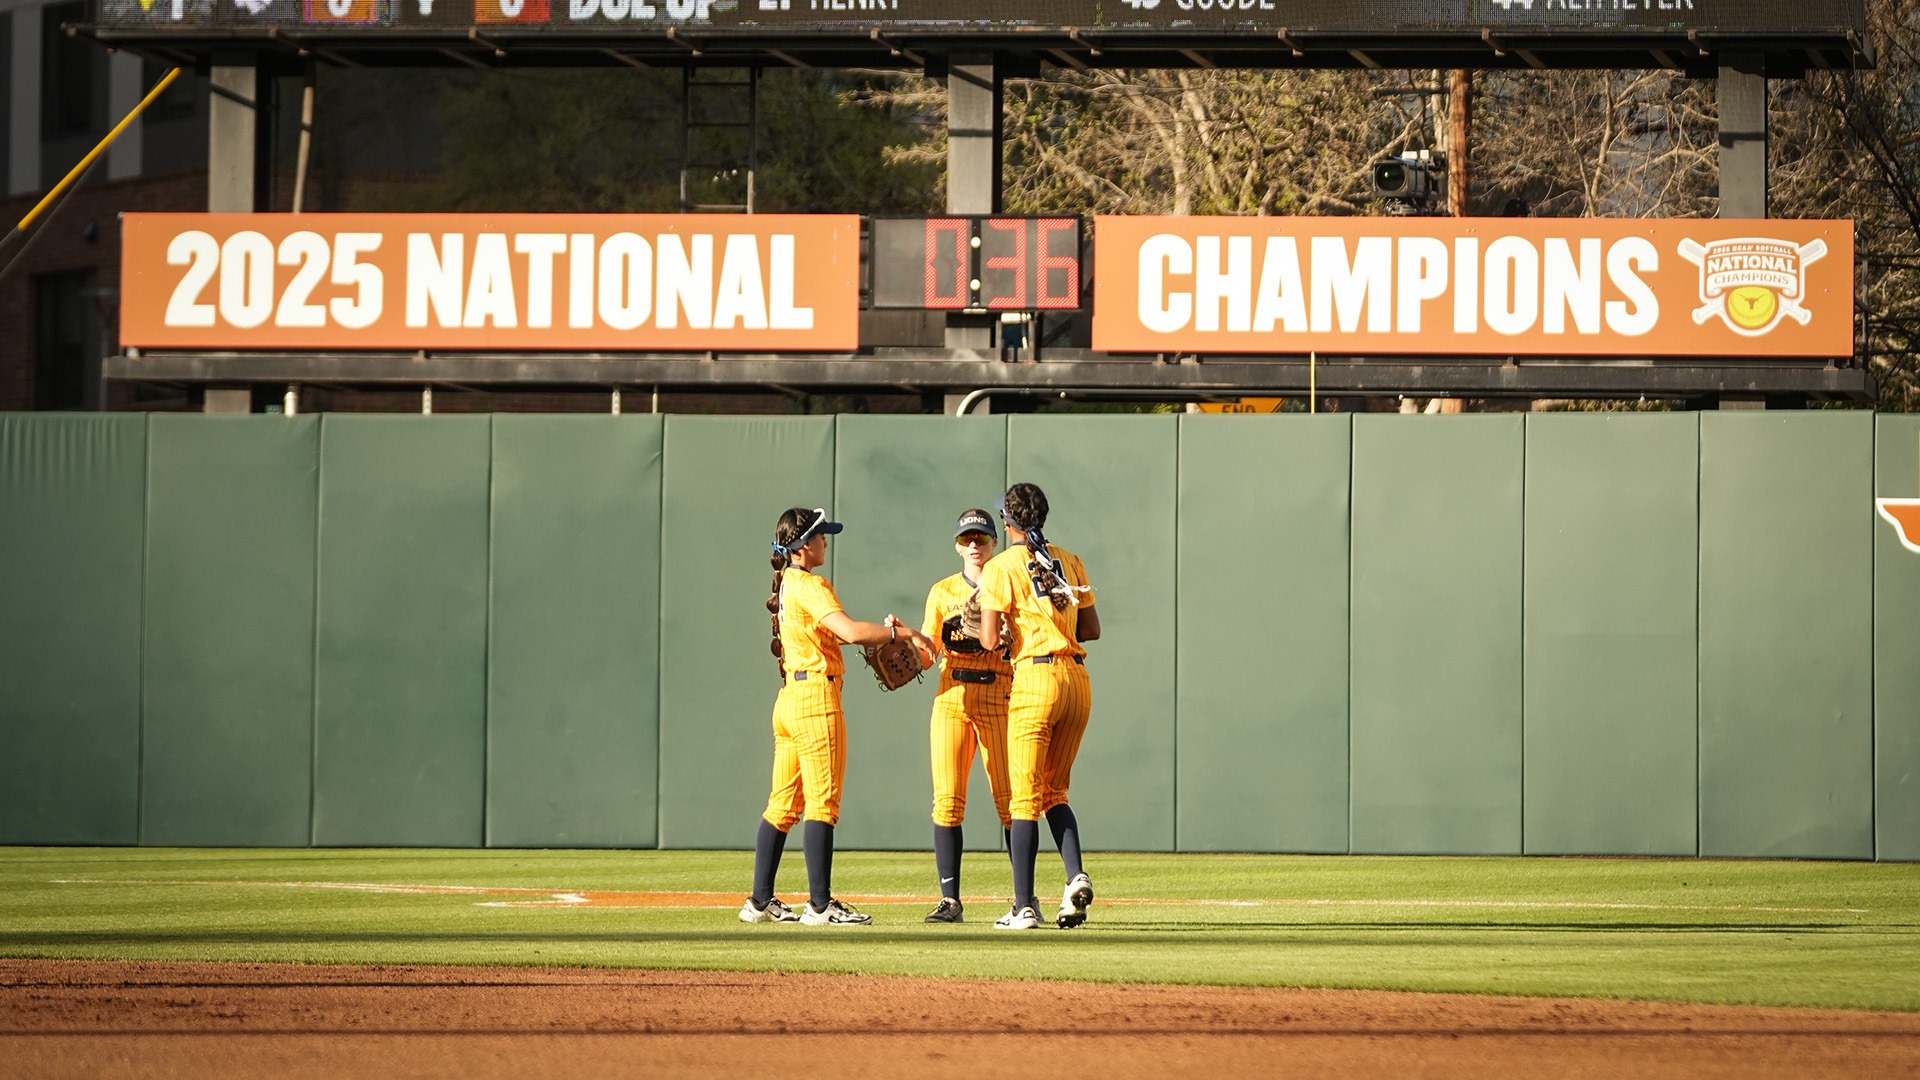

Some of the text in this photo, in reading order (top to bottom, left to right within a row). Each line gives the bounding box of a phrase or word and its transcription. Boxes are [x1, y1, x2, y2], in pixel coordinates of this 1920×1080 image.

[1755, 245, 1792, 254] SOFTBALL
[1707, 255, 1797, 274] NATIONAL
[165, 230, 814, 331] 2025 NATIONAL
[1137, 233, 1659, 336] CHAMPIONS
[1714, 272, 1789, 285] CHAMPIONS
[960, 516, 987, 527] LIONS
